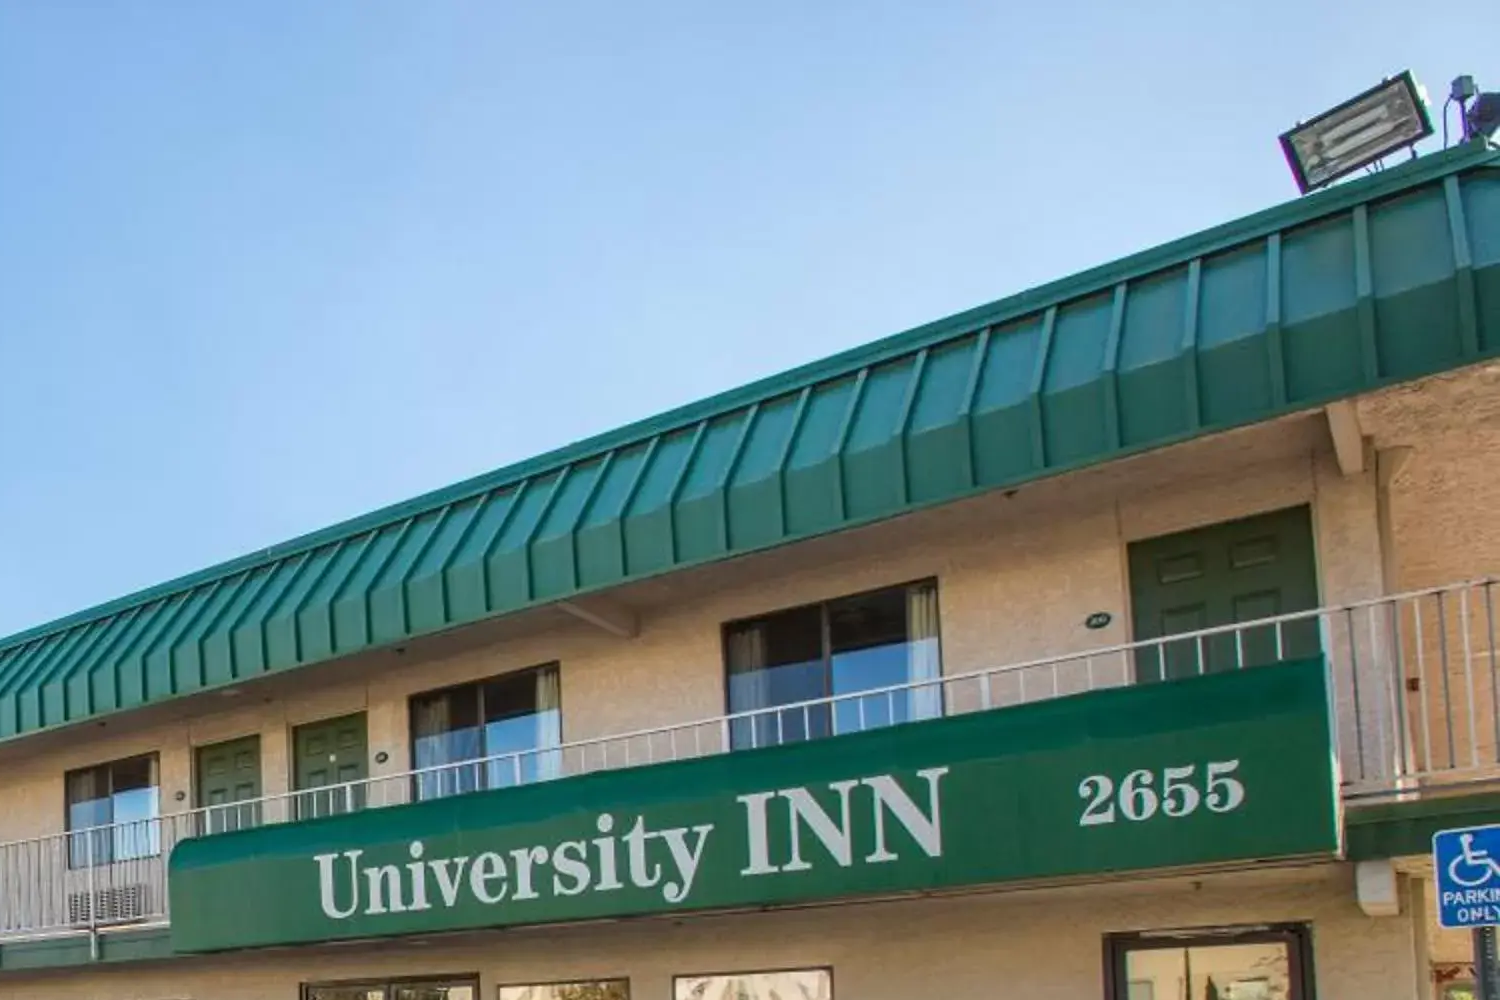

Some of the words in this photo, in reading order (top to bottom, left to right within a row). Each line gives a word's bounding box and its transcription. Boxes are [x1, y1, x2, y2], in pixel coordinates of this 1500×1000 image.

[314, 812, 714, 919] University
[737, 766, 950, 876] INN
[1078, 758, 1245, 827] 2655
